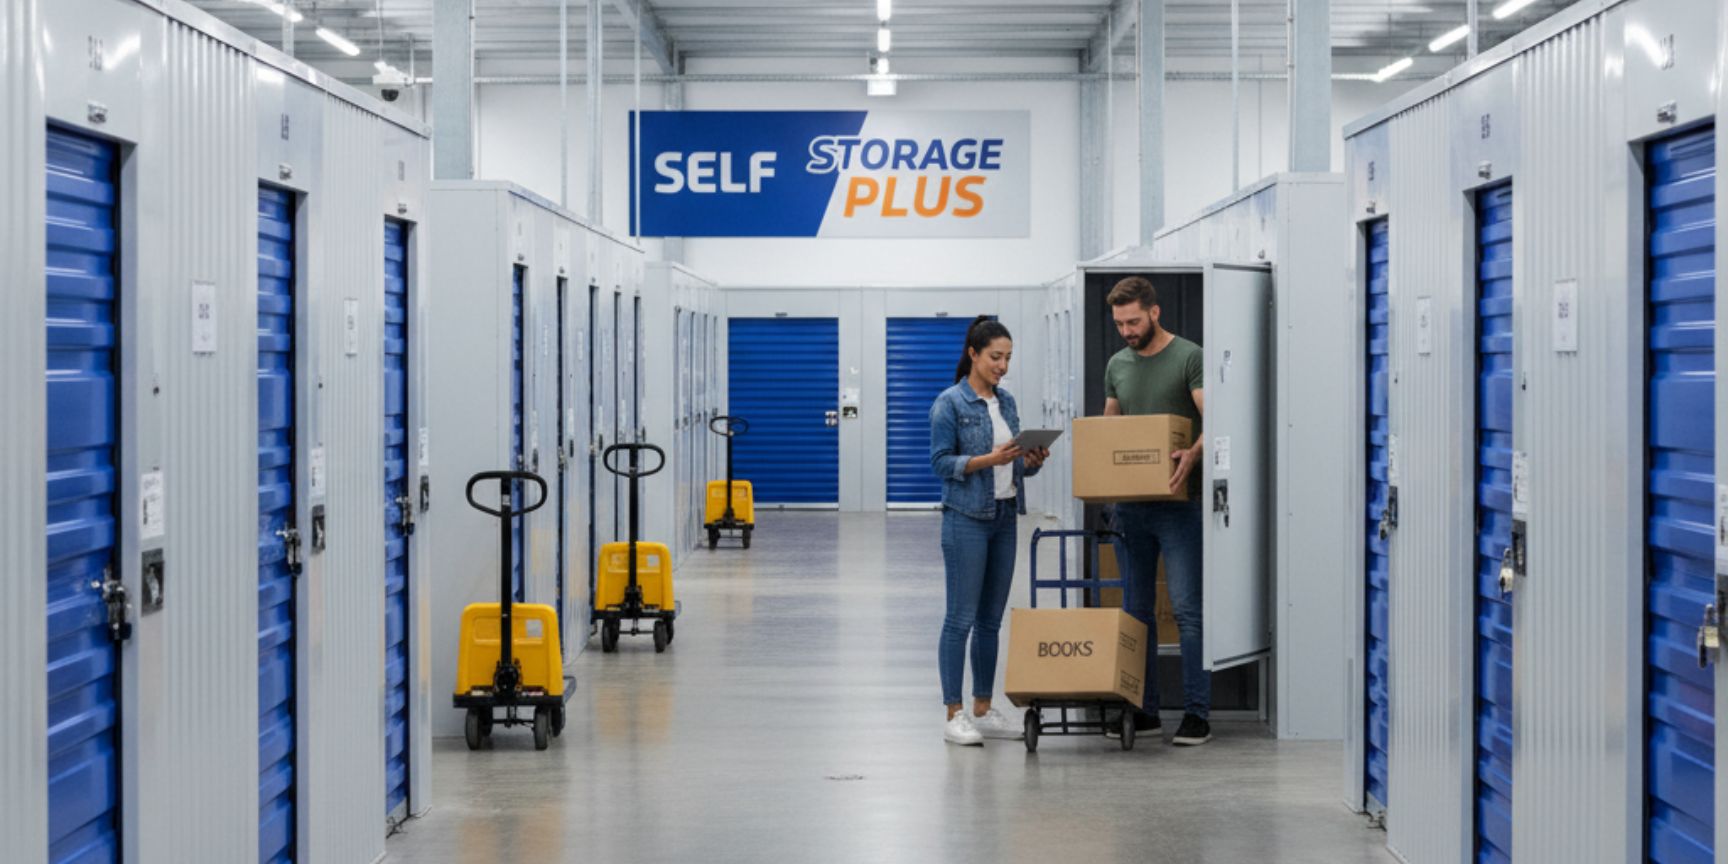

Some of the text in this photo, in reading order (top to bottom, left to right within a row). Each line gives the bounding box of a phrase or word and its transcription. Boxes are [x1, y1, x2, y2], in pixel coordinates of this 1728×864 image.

[654, 152, 777, 194] SELF
[807, 136, 1004, 173] STORAGE
[843, 176, 986, 218] PLUS
[1037, 640, 1094, 657] BOOKS
